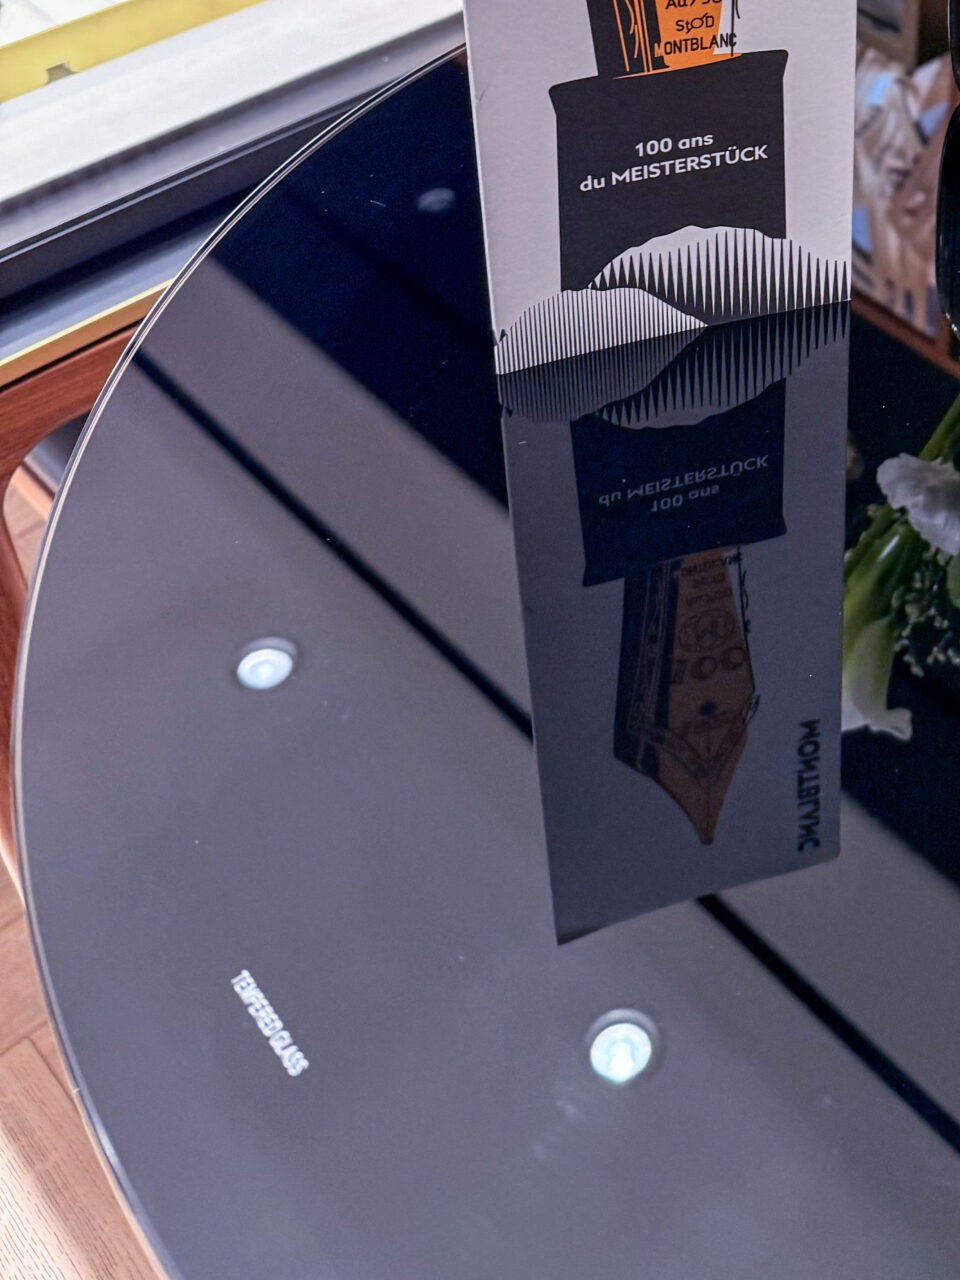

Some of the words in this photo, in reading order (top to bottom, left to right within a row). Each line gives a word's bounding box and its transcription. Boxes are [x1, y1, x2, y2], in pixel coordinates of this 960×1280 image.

[654, 32, 738, 59] MONTBLANC
[635, 142, 672, 157] 100
[678, 134, 715, 150] ans
[579, 175, 606, 192] du
[611, 144, 769, 187] MEISTERSTÜCK
[268, 1030, 310, 1077] GLASS
